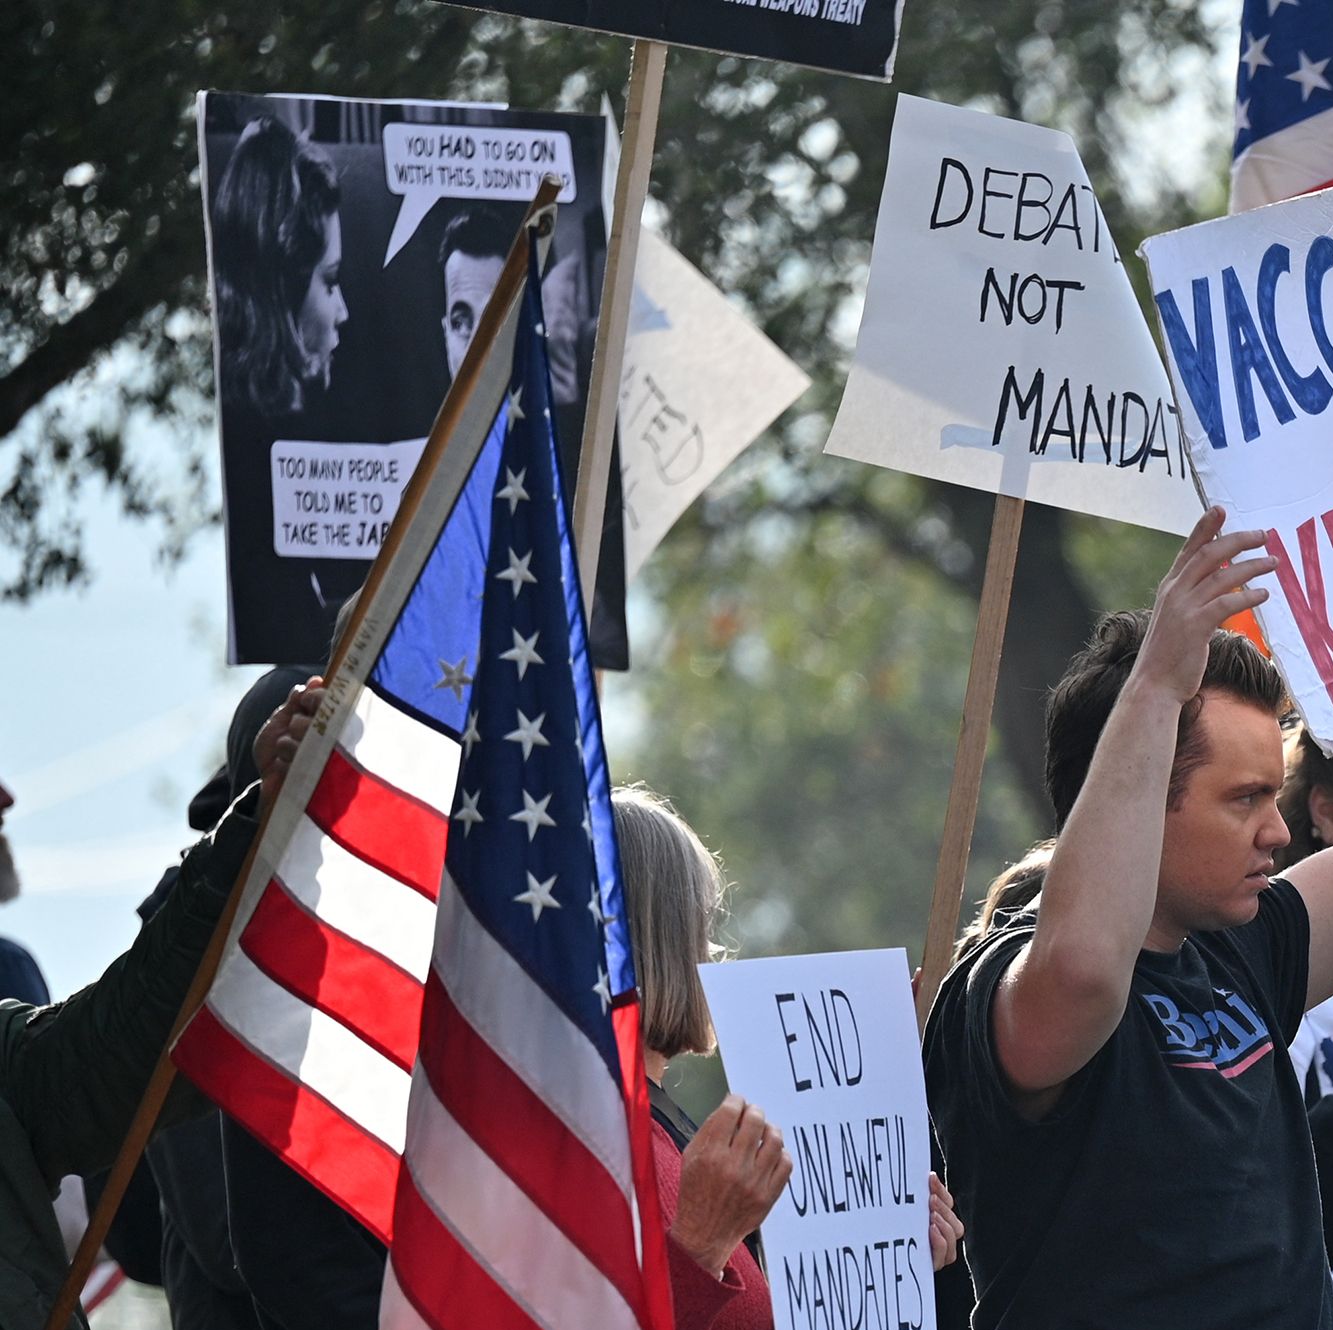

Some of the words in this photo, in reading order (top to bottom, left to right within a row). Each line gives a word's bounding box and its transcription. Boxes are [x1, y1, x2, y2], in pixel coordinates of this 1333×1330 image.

[405, 136, 435, 157] YOU
[439, 134, 476, 158] HAD
[482, 140, 501, 160] TO
[505, 141, 527, 162] GO
[529, 140, 556, 163] ON
[394, 162, 434, 185] WITH
[438, 164, 480, 191] THIS,
[930, 157, 1122, 264] DEBAT
[980, 267, 1085, 334] NOT
[277, 456, 306, 479] TOO
[308, 458, 344, 481] MANY
[348, 459, 399, 483] PEOPLE
[294, 489, 330, 513] TOLD
[333, 490, 357, 514] ME
[361, 492, 384, 515] TO
[282, 522, 318, 545] TAKE
[322, 523, 350, 547] THE
[775, 988, 863, 1092] END
[788, 1114, 915, 1218] UNLAWFUL
